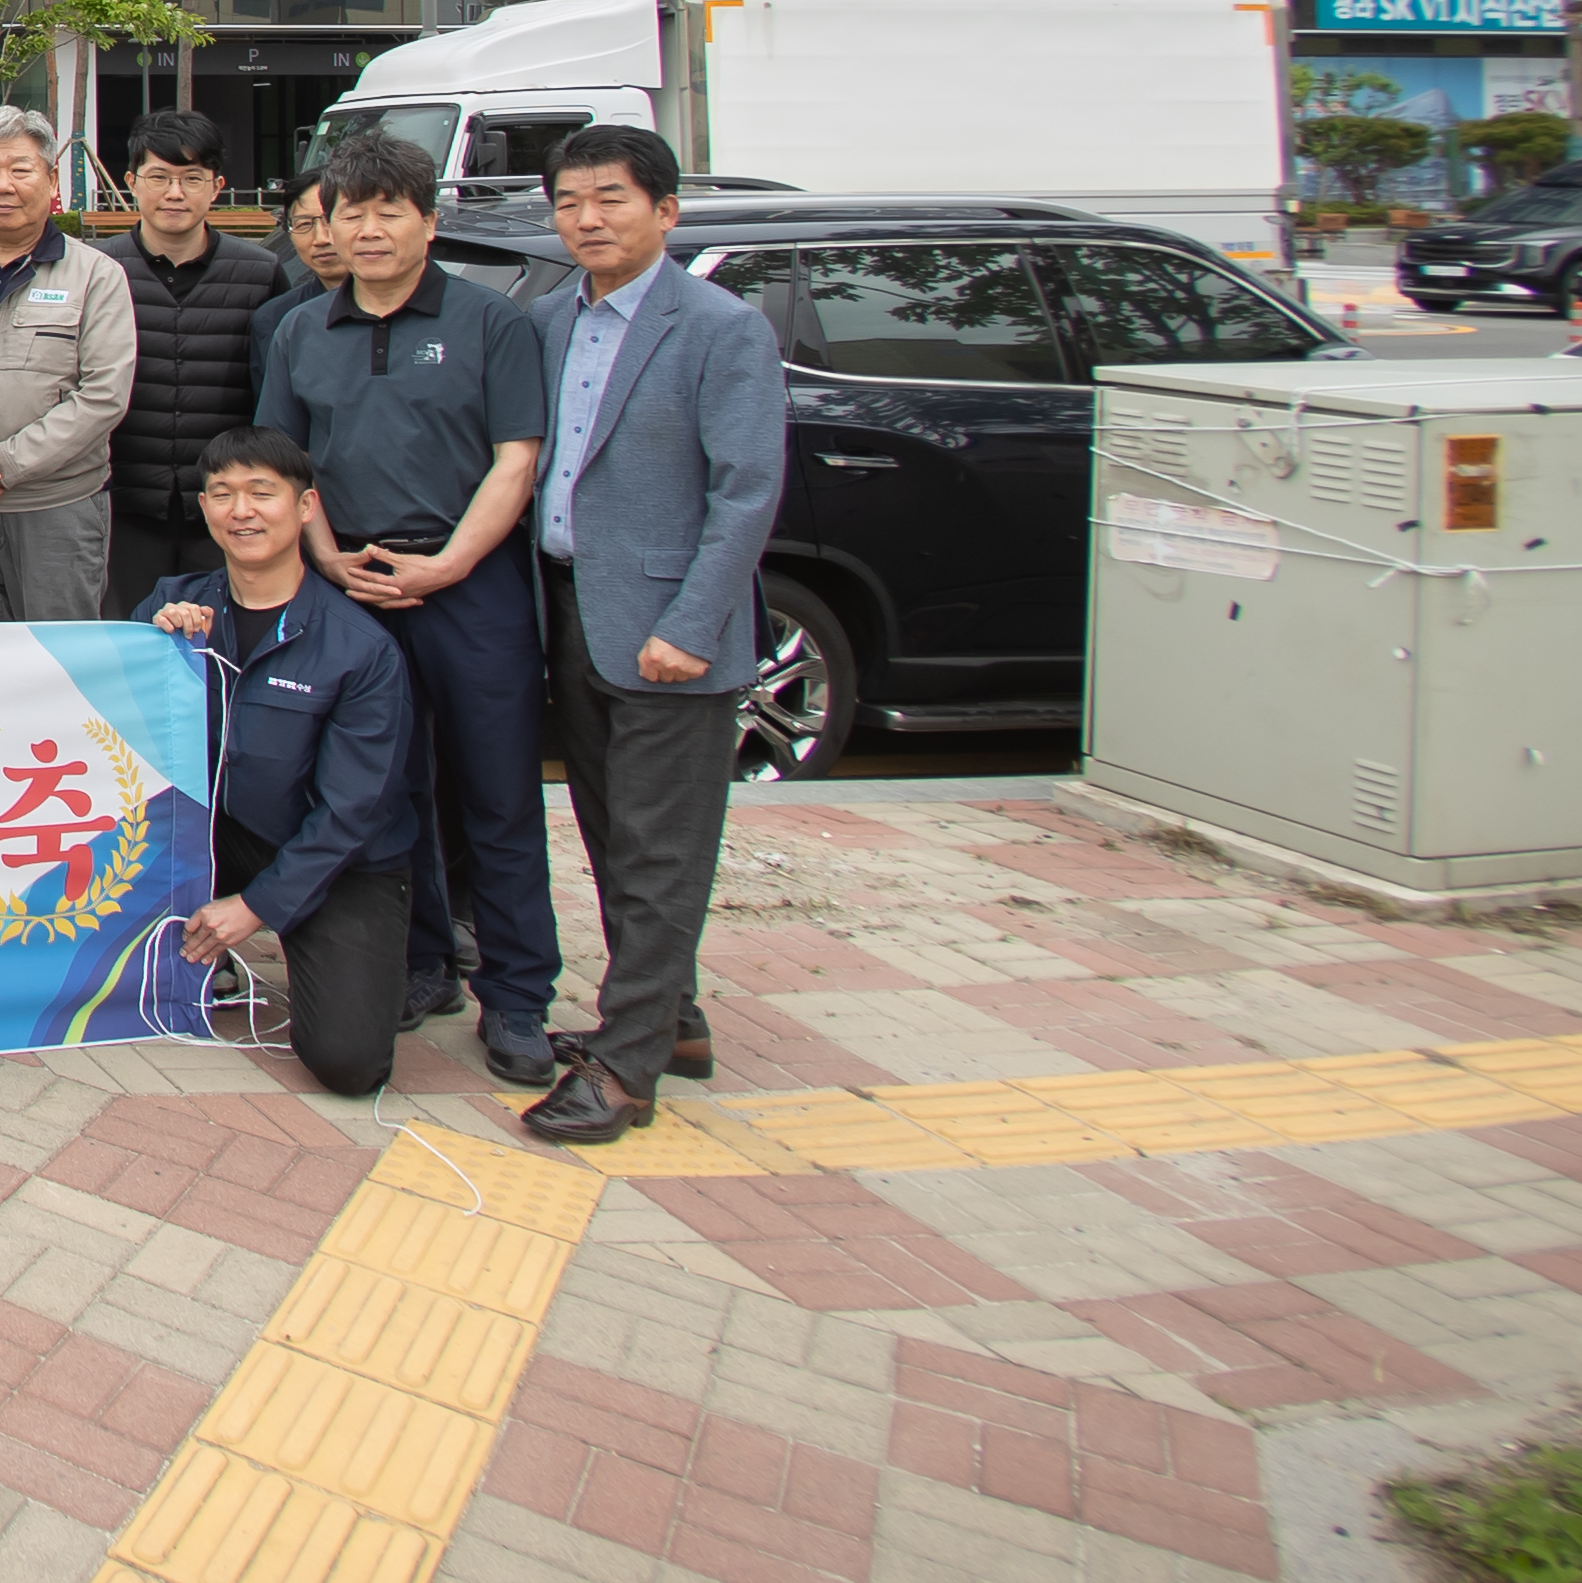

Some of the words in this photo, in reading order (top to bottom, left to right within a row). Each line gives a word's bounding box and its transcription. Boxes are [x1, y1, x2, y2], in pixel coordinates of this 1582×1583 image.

[157, 52, 175, 67] IN
[248, 48, 260, 63] P
[333, 52, 350, 67] IN
